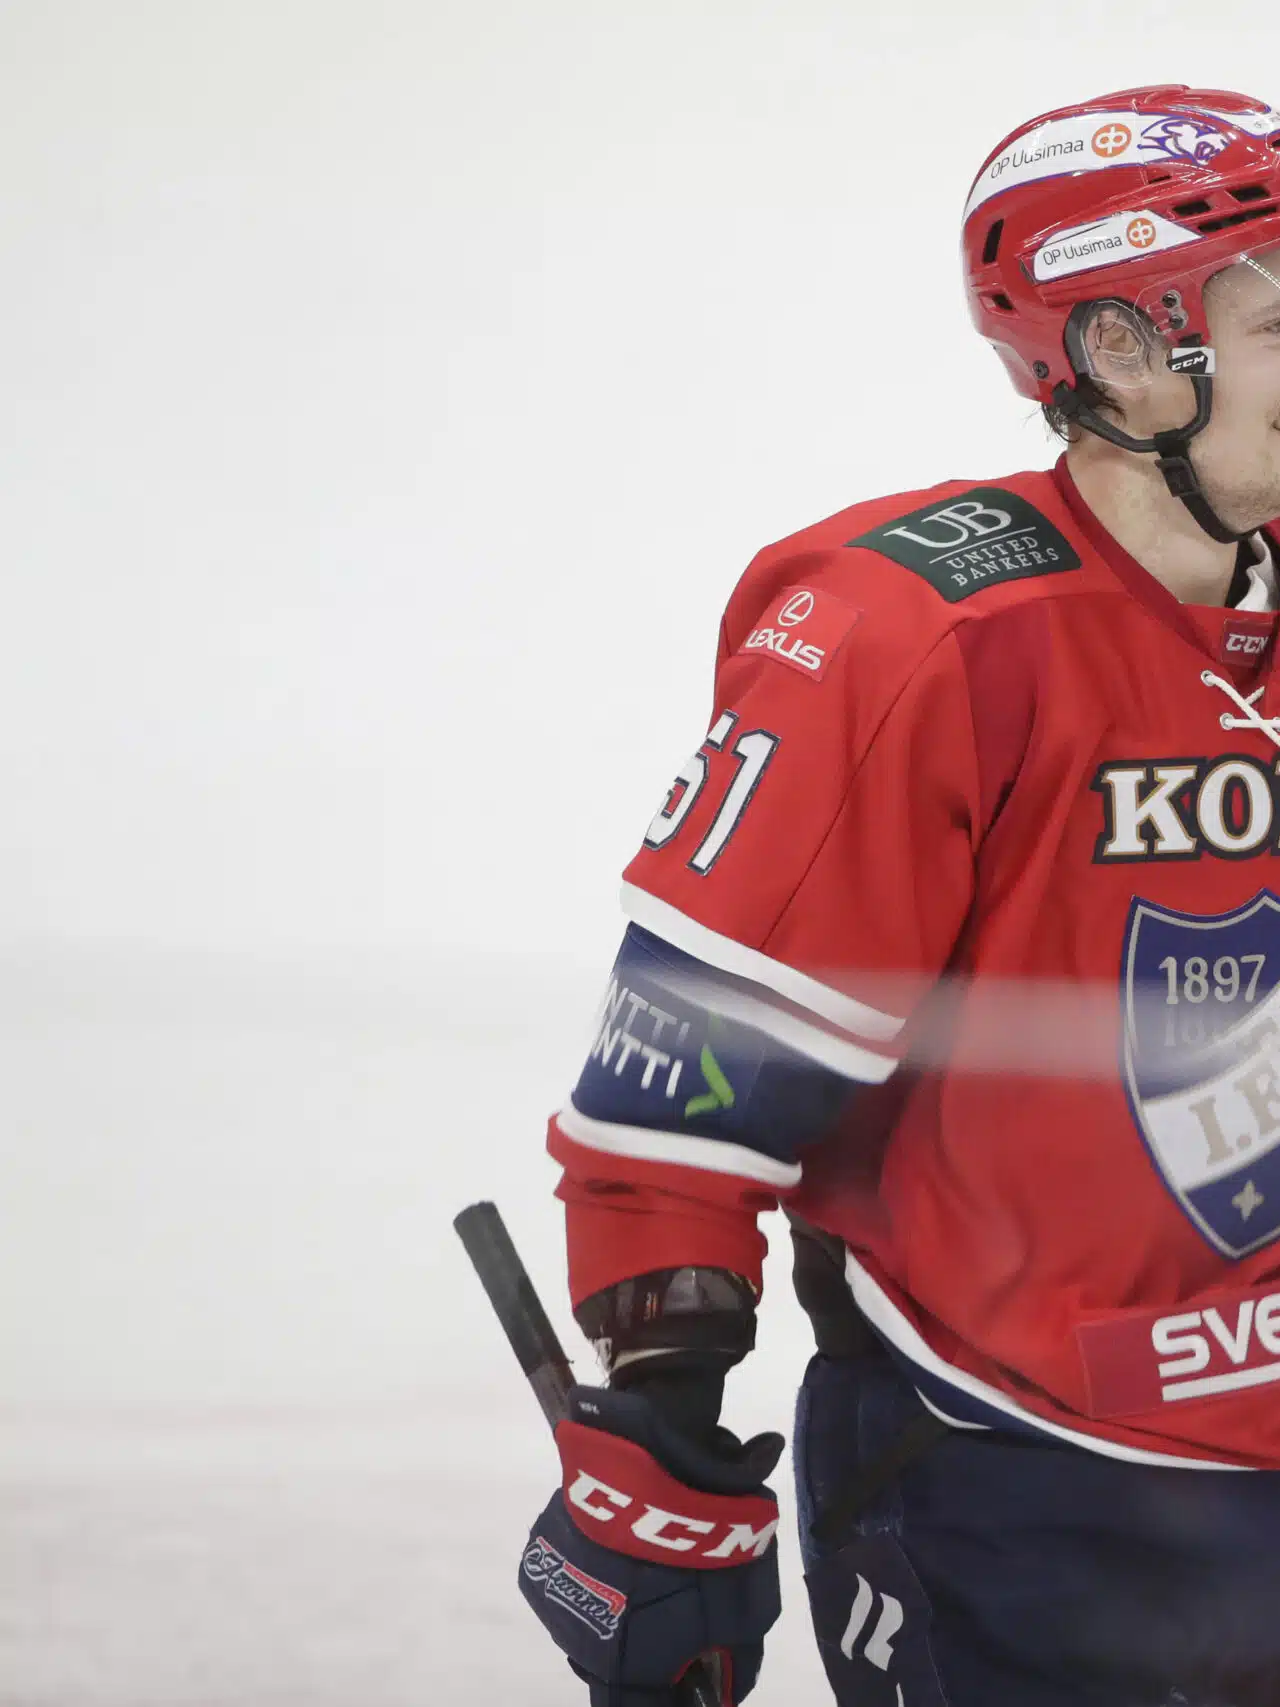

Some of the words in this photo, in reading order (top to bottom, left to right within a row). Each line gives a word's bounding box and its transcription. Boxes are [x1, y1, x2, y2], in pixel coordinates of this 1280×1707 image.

[990, 157, 1009, 179] OP
[1012, 139, 1084, 168] Uusimaa
[1042, 249, 1061, 266] OP
[1063, 235, 1123, 260] Uusimaa
[1171, 355, 1205, 371] CCM
[883, 501, 1012, 548] UB
[946, 537, 1038, 569] UNITED
[951, 548, 1060, 587] BANKERS
[745, 628, 825, 670] LEXUS
[1158, 954, 1267, 1005] 1897
[568, 1469, 779, 1559] CCM
